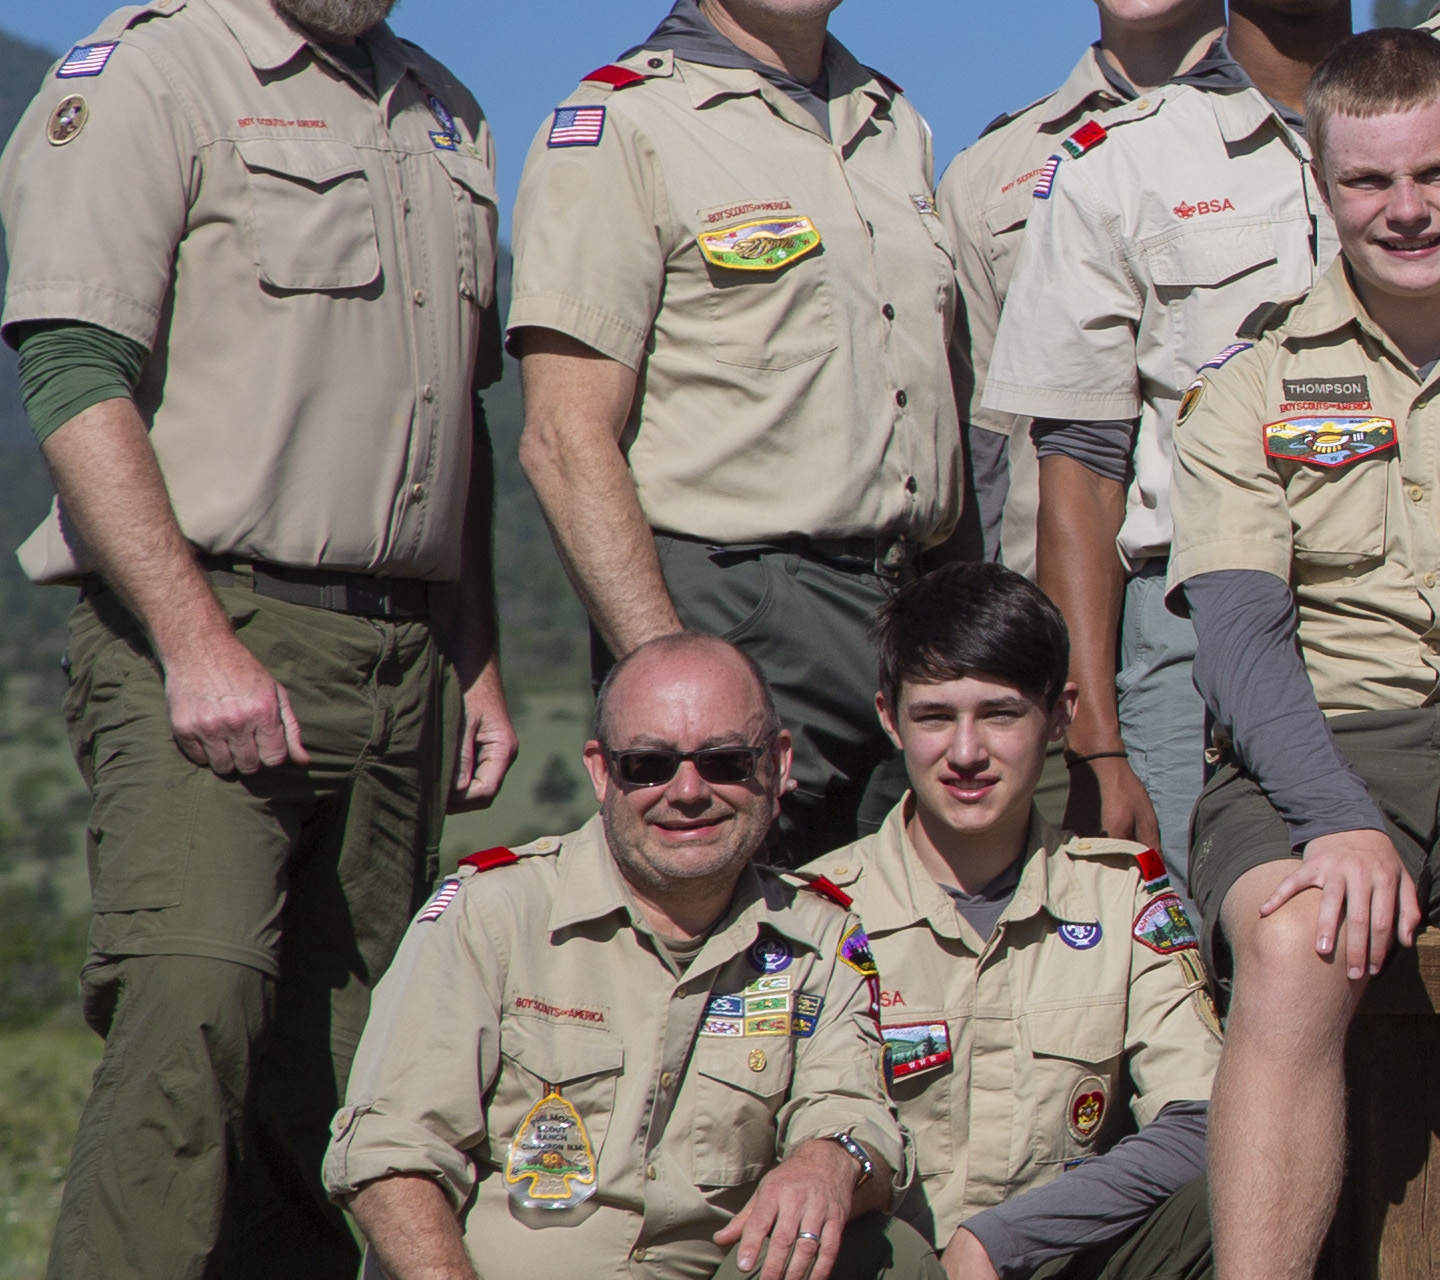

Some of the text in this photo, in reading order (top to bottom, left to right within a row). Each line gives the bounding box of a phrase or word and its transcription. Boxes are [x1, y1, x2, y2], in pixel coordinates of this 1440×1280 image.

[1196, 198, 1236, 216] BSA
[1286, 382, 1362, 395] THOMPSON
[879, 990, 907, 1008] SA
[532, 1001, 561, 1018] SCOUTS
[567, 1007, 605, 1023] AMERICA
